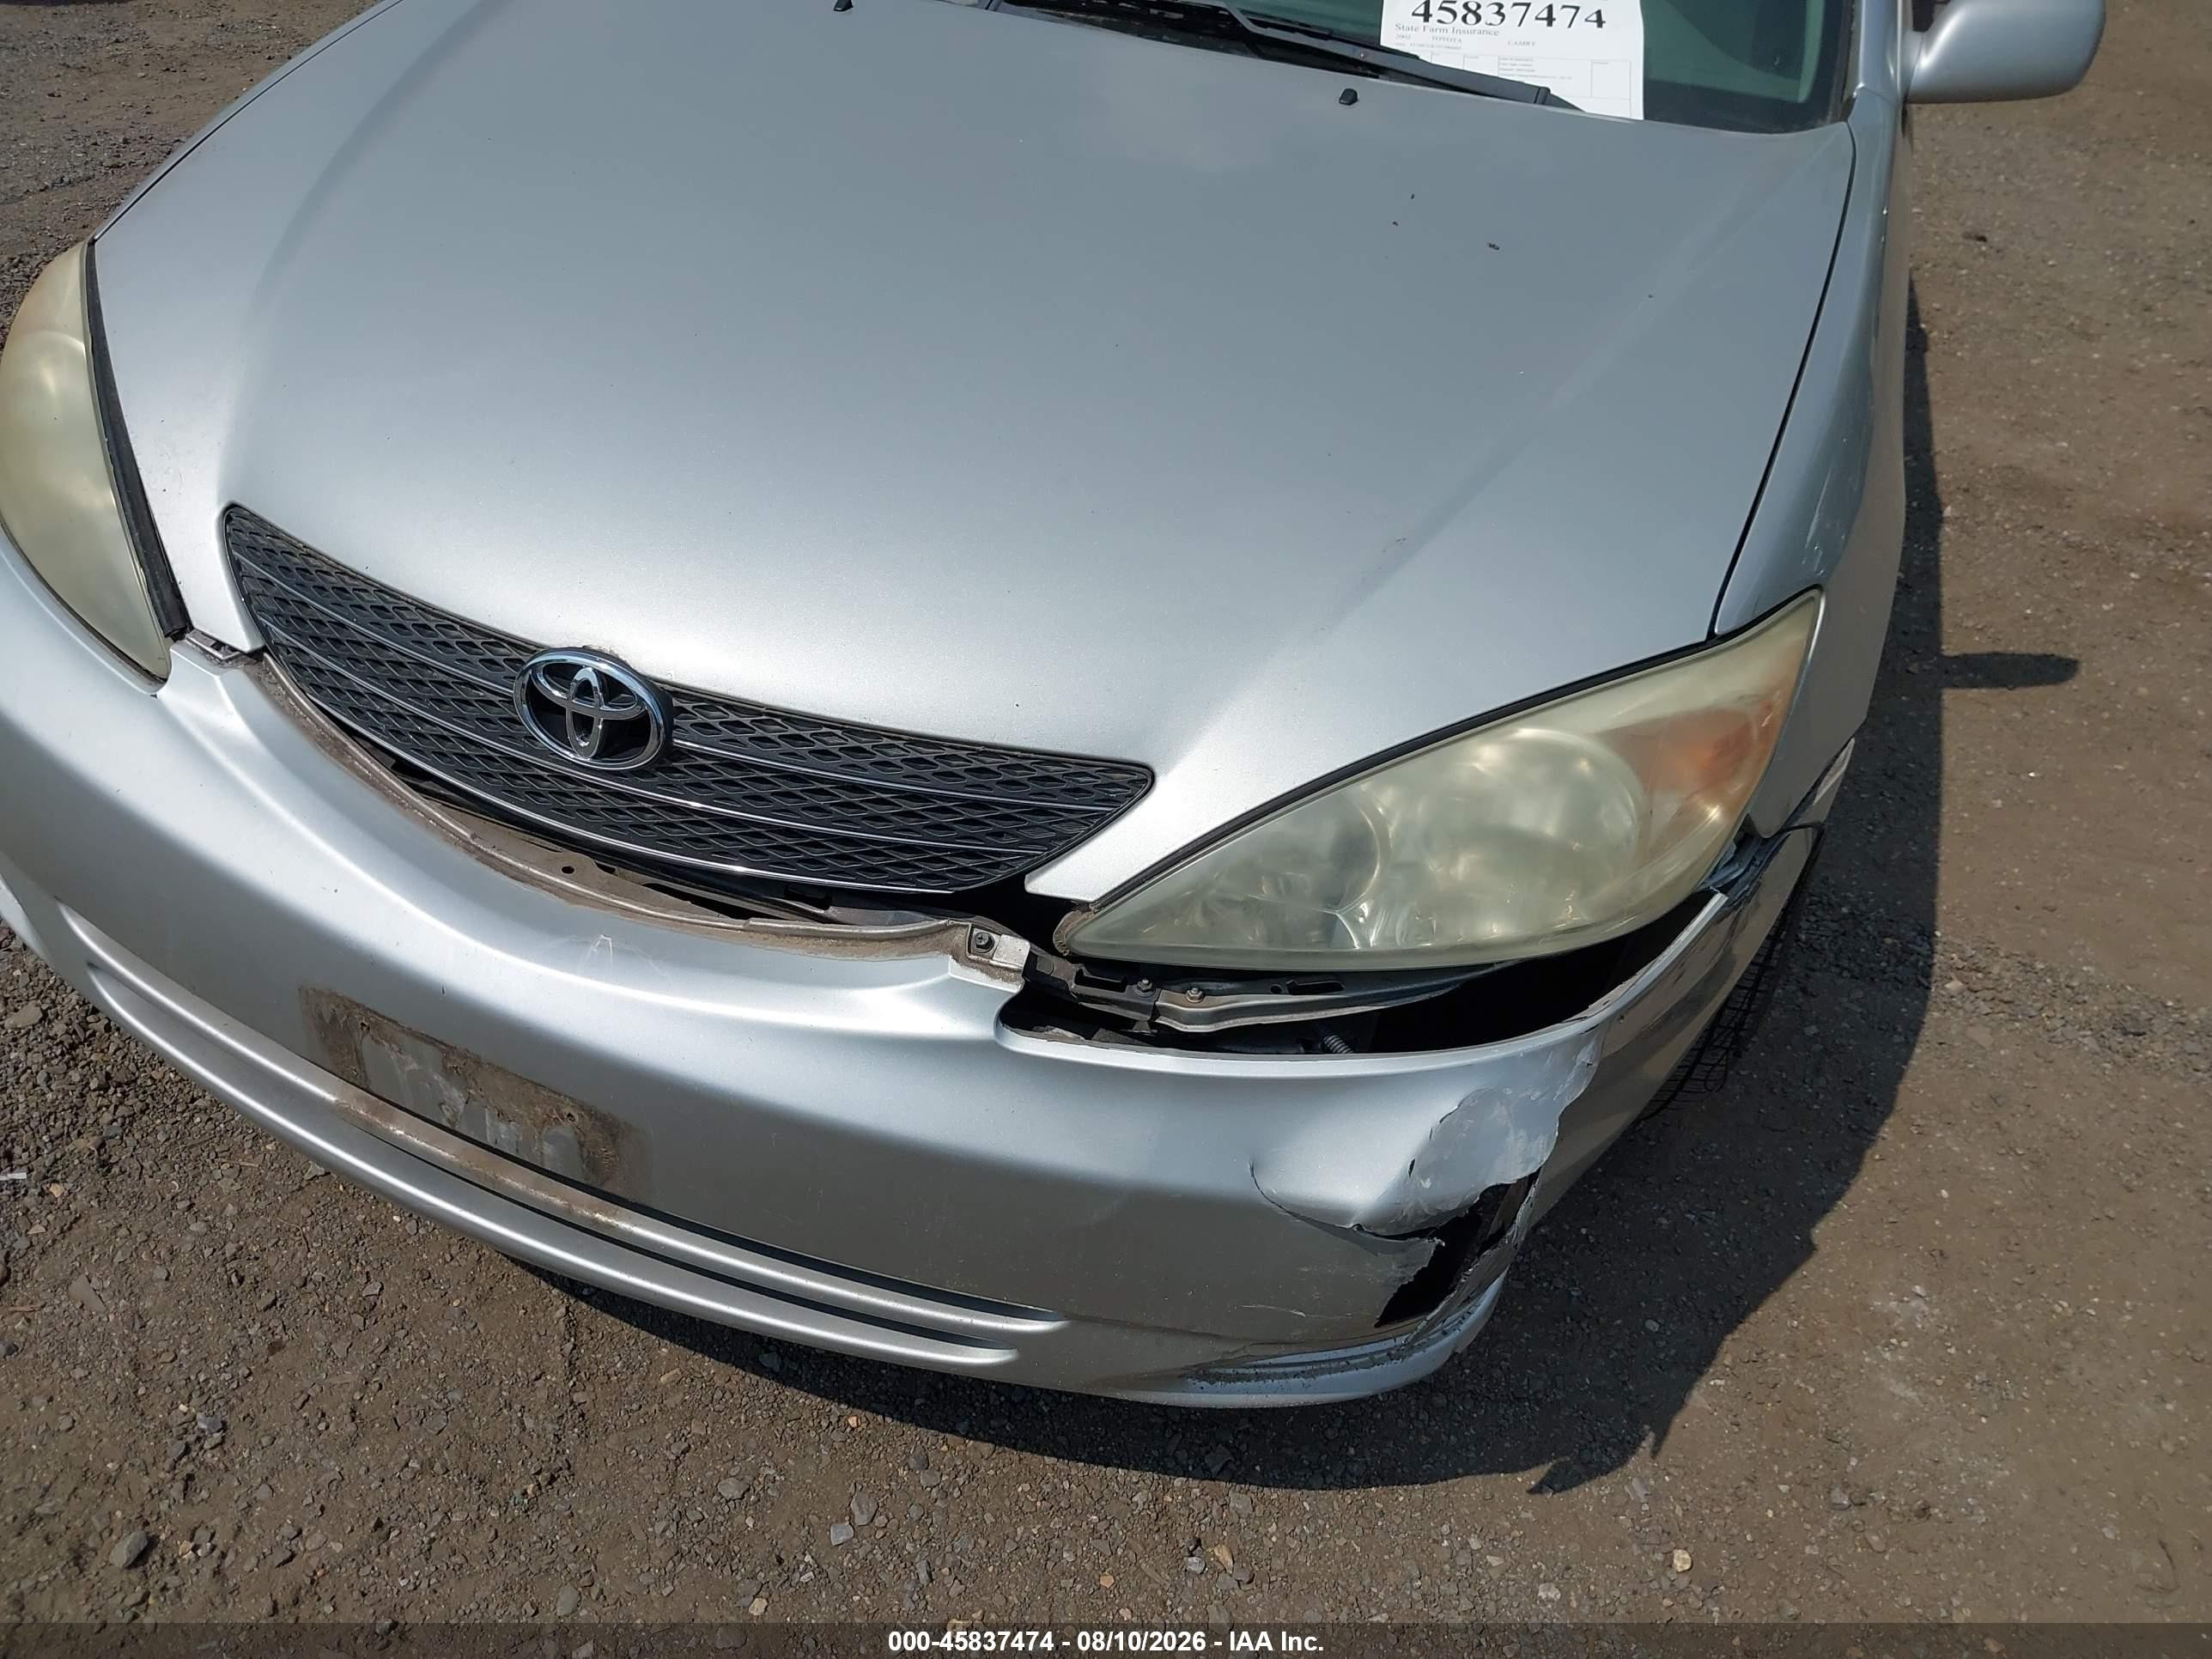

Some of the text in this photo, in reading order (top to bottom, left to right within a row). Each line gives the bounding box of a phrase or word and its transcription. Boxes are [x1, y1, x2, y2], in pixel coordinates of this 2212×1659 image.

[1412, 0, 1607, 28] 45837474
[1395, 23, 1500, 36] State Farm Insurance
